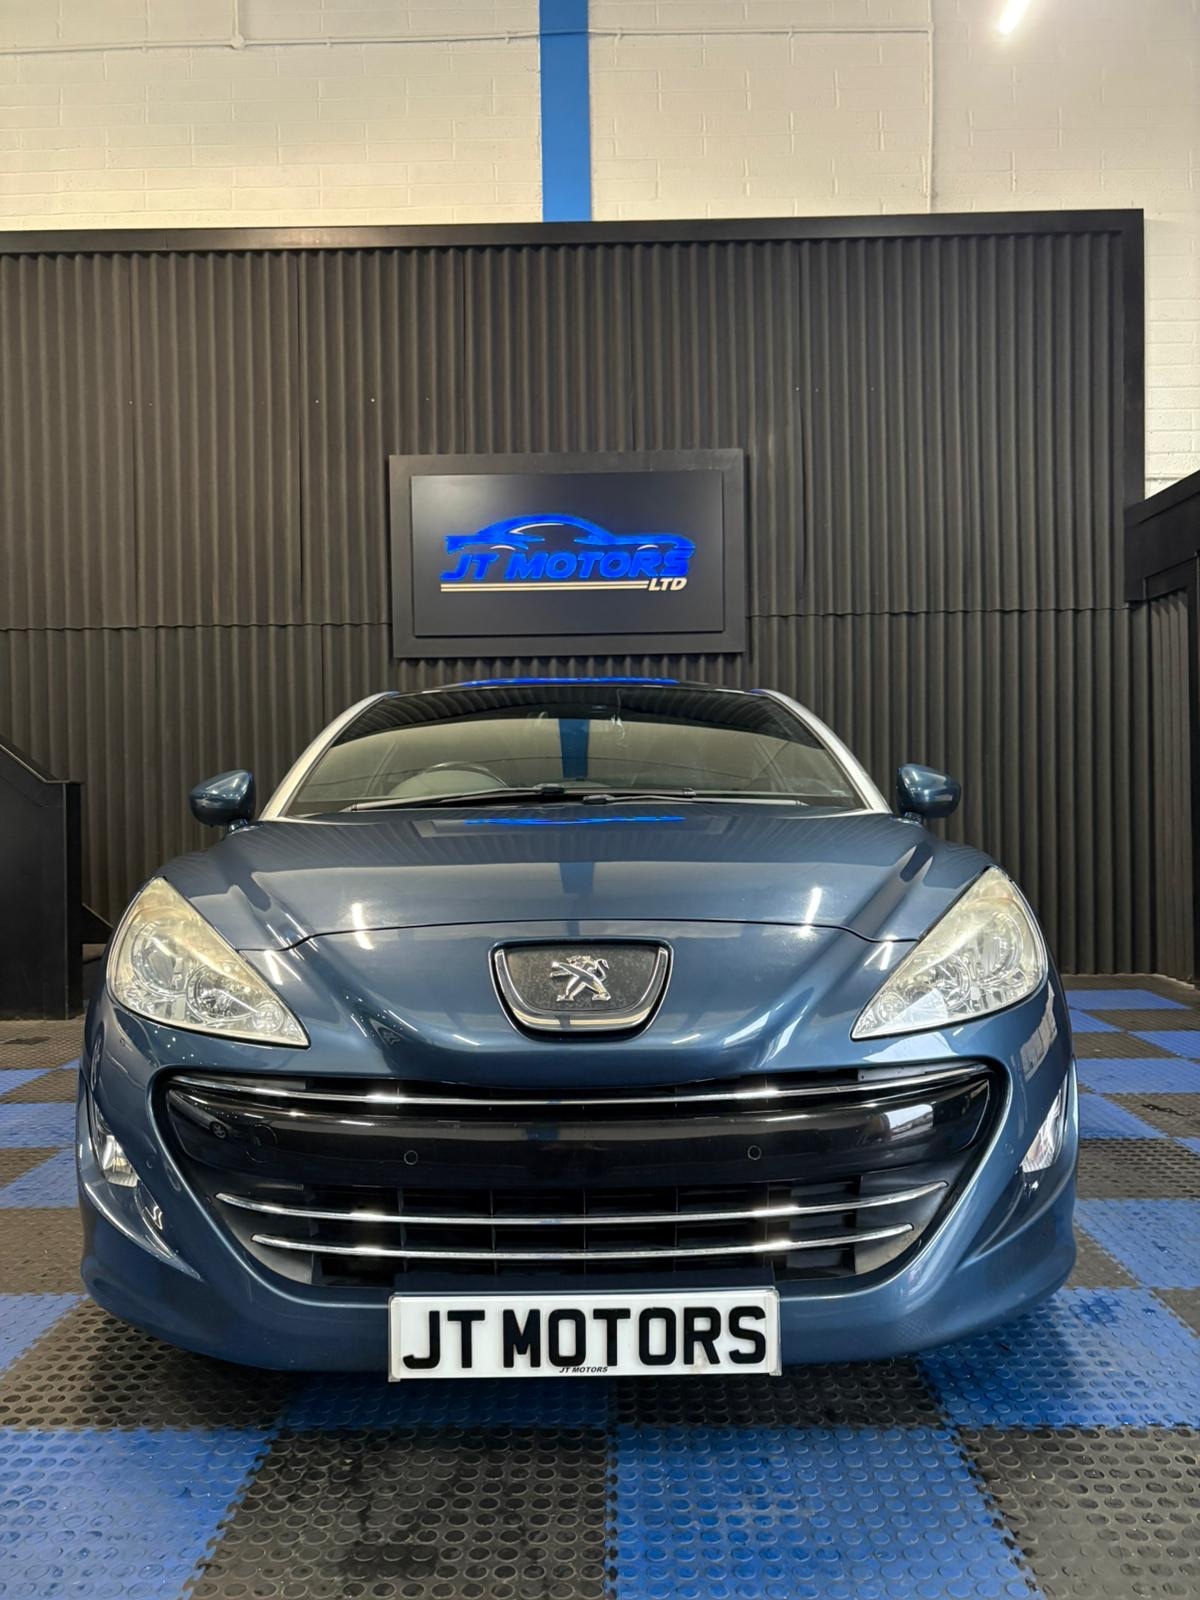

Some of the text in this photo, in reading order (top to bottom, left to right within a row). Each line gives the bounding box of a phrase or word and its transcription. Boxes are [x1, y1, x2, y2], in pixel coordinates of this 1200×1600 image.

[440, 550, 692, 581] JT MOTORS
[648, 577, 688, 592] LTD
[402, 1305, 767, 1370] JT MOTORS
[559, 1366, 570, 1374] JT
